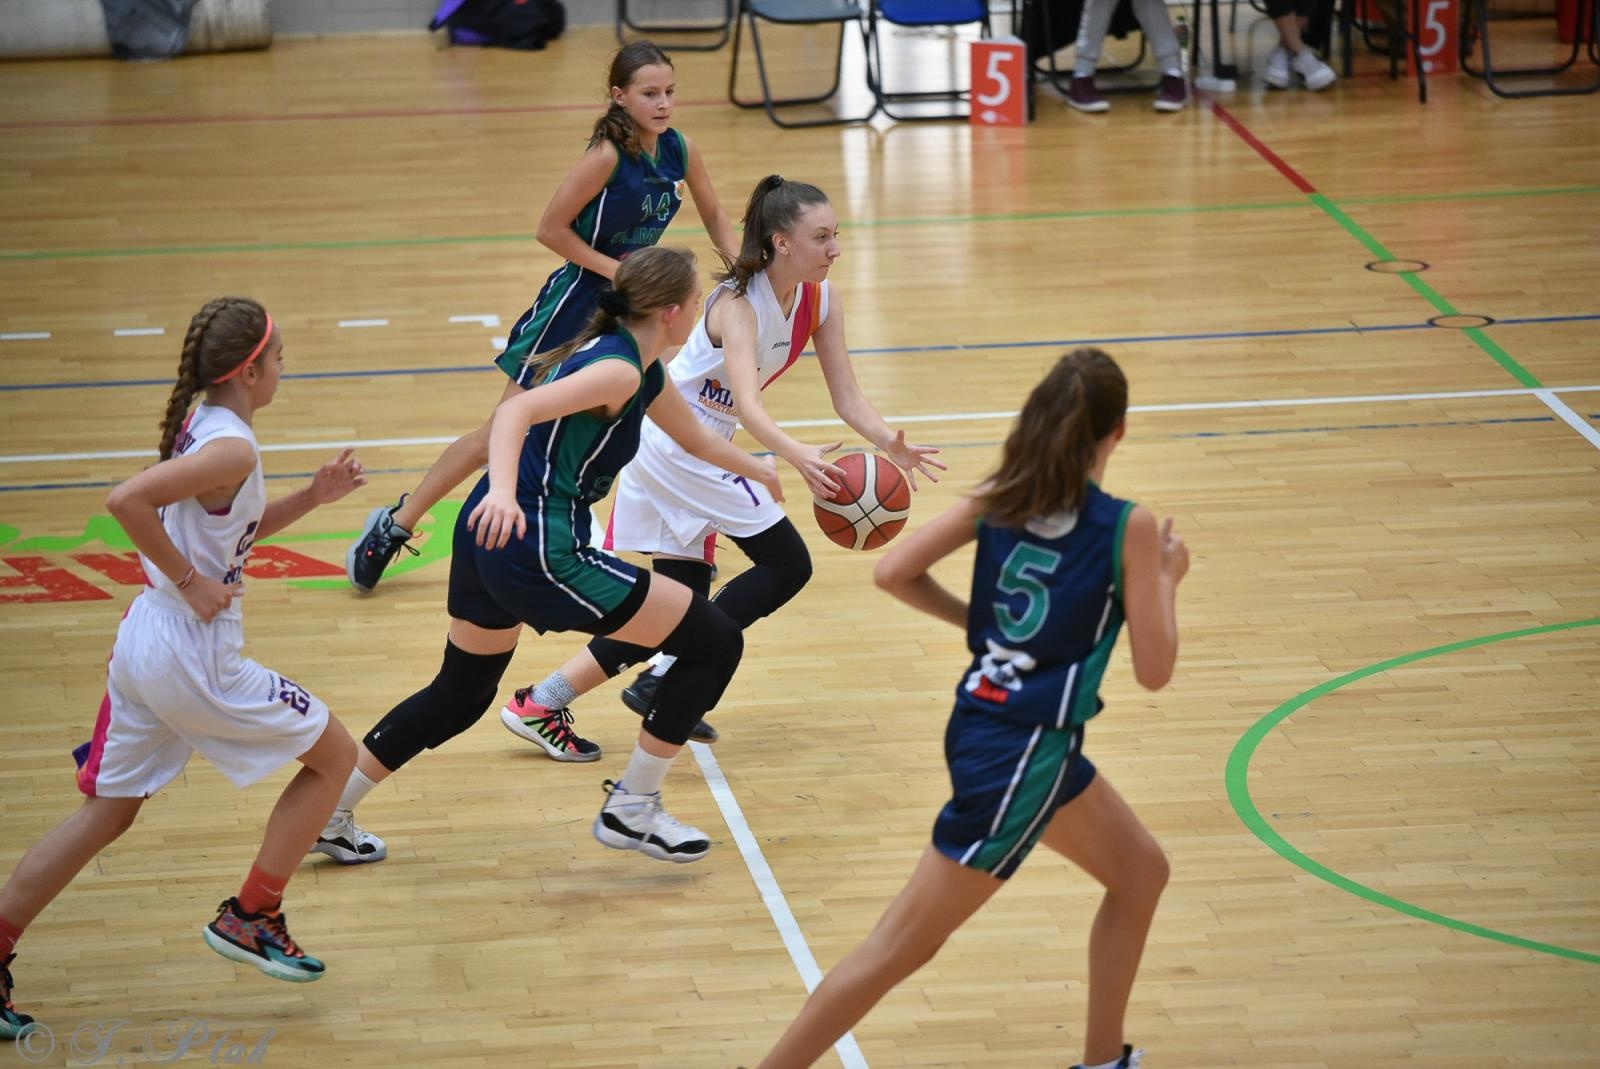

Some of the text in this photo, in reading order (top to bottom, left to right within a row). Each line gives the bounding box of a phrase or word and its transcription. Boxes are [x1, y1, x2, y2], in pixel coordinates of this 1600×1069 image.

[1418, 1, 1450, 56] 5
[977, 50, 1014, 107] 5
[641, 190, 671, 222] 14
[992, 541, 1062, 643] 5
